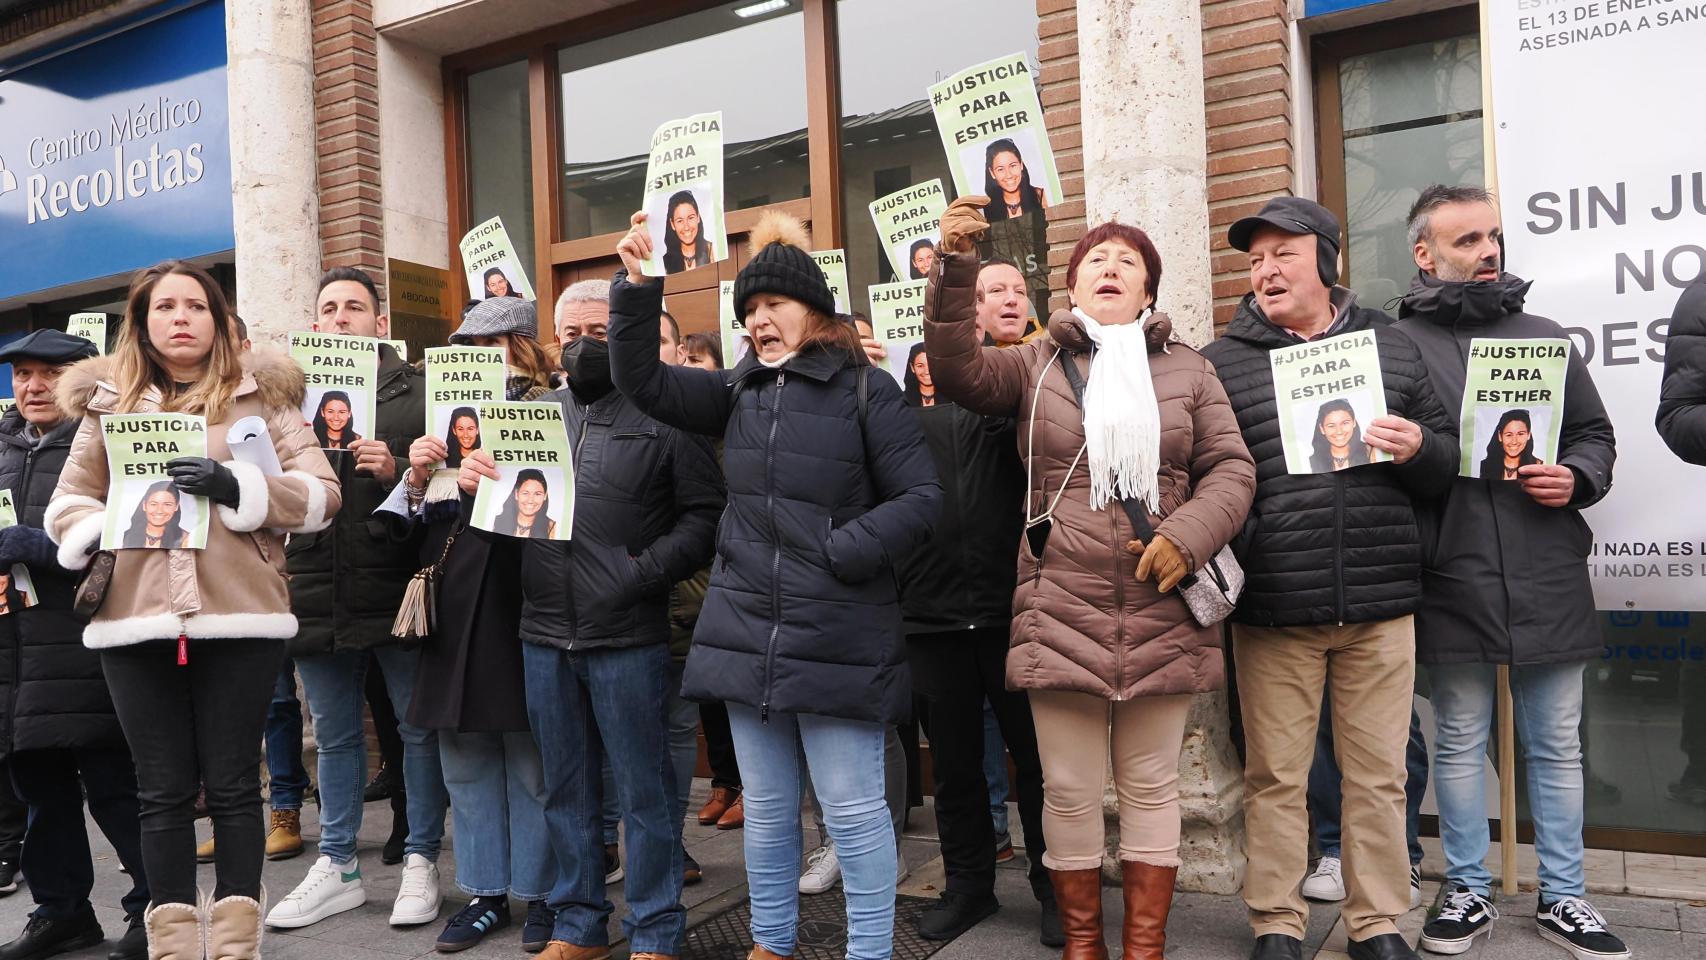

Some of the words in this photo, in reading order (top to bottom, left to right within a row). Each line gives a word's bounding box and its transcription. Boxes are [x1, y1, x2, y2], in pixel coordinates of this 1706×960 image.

[1519, 17, 1541, 31] EL
[1548, 11, 1567, 26] 13
[1574, 3, 1600, 21] DE
[1519, 20, 1632, 51] ASESINADA
[1637, 15, 1651, 31] A
[933, 61, 1028, 106] #JUSTICIA
[959, 91, 1011, 117] PARA
[28, 127, 102, 169] Centro
[108, 96, 202, 147] Médico
[955, 110, 1029, 145] ESTHER
[650, 120, 720, 152] JUSTICIA
[654, 144, 696, 167] PARA
[26, 141, 205, 225] Recoletas
[647, 164, 708, 193] ESTHER
[874, 184, 942, 216] #JUSTICIA
[892, 205, 929, 225] PARA
[1526, 182, 1627, 235] SIN
[889, 219, 940, 245] ESTHER
[469, 241, 494, 259] PARA
[469, 250, 506, 273] ESTHER
[401, 290, 440, 305] ABOGADA
[872, 286, 926, 302] #JUST
[895, 305, 924, 319] PAR
[292, 337, 375, 352] #JUSTICIA
[1274, 337, 1374, 366] #JUSTICIA
[1471, 346, 1567, 359] #JUSTICIA
[313, 356, 355, 368] PARA
[427, 353, 503, 364] #JUSTICIA
[1300, 358, 1351, 378] PARA
[1490, 369, 1542, 380] PARA
[304, 373, 365, 386] ESTHER
[442, 371, 482, 382] PARA
[434, 390, 492, 401] ESTHER
[1291, 375, 1366, 400] ESTHER
[1477, 390, 1552, 402] ESTHER
[480, 408, 562, 421] #JUSTICIA
[105, 420, 204, 434] #JUSTICIA
[500, 430, 545, 441] PARA
[133, 441, 179, 454] PARA
[493, 450, 558, 462] ESTHER
[124, 463, 169, 475] ESTH
[1605, 542, 1661, 556] NADA
[1667, 542, 1693, 556] ES
[1605, 563, 1662, 577] NADA
[1667, 563, 1694, 577] ES
